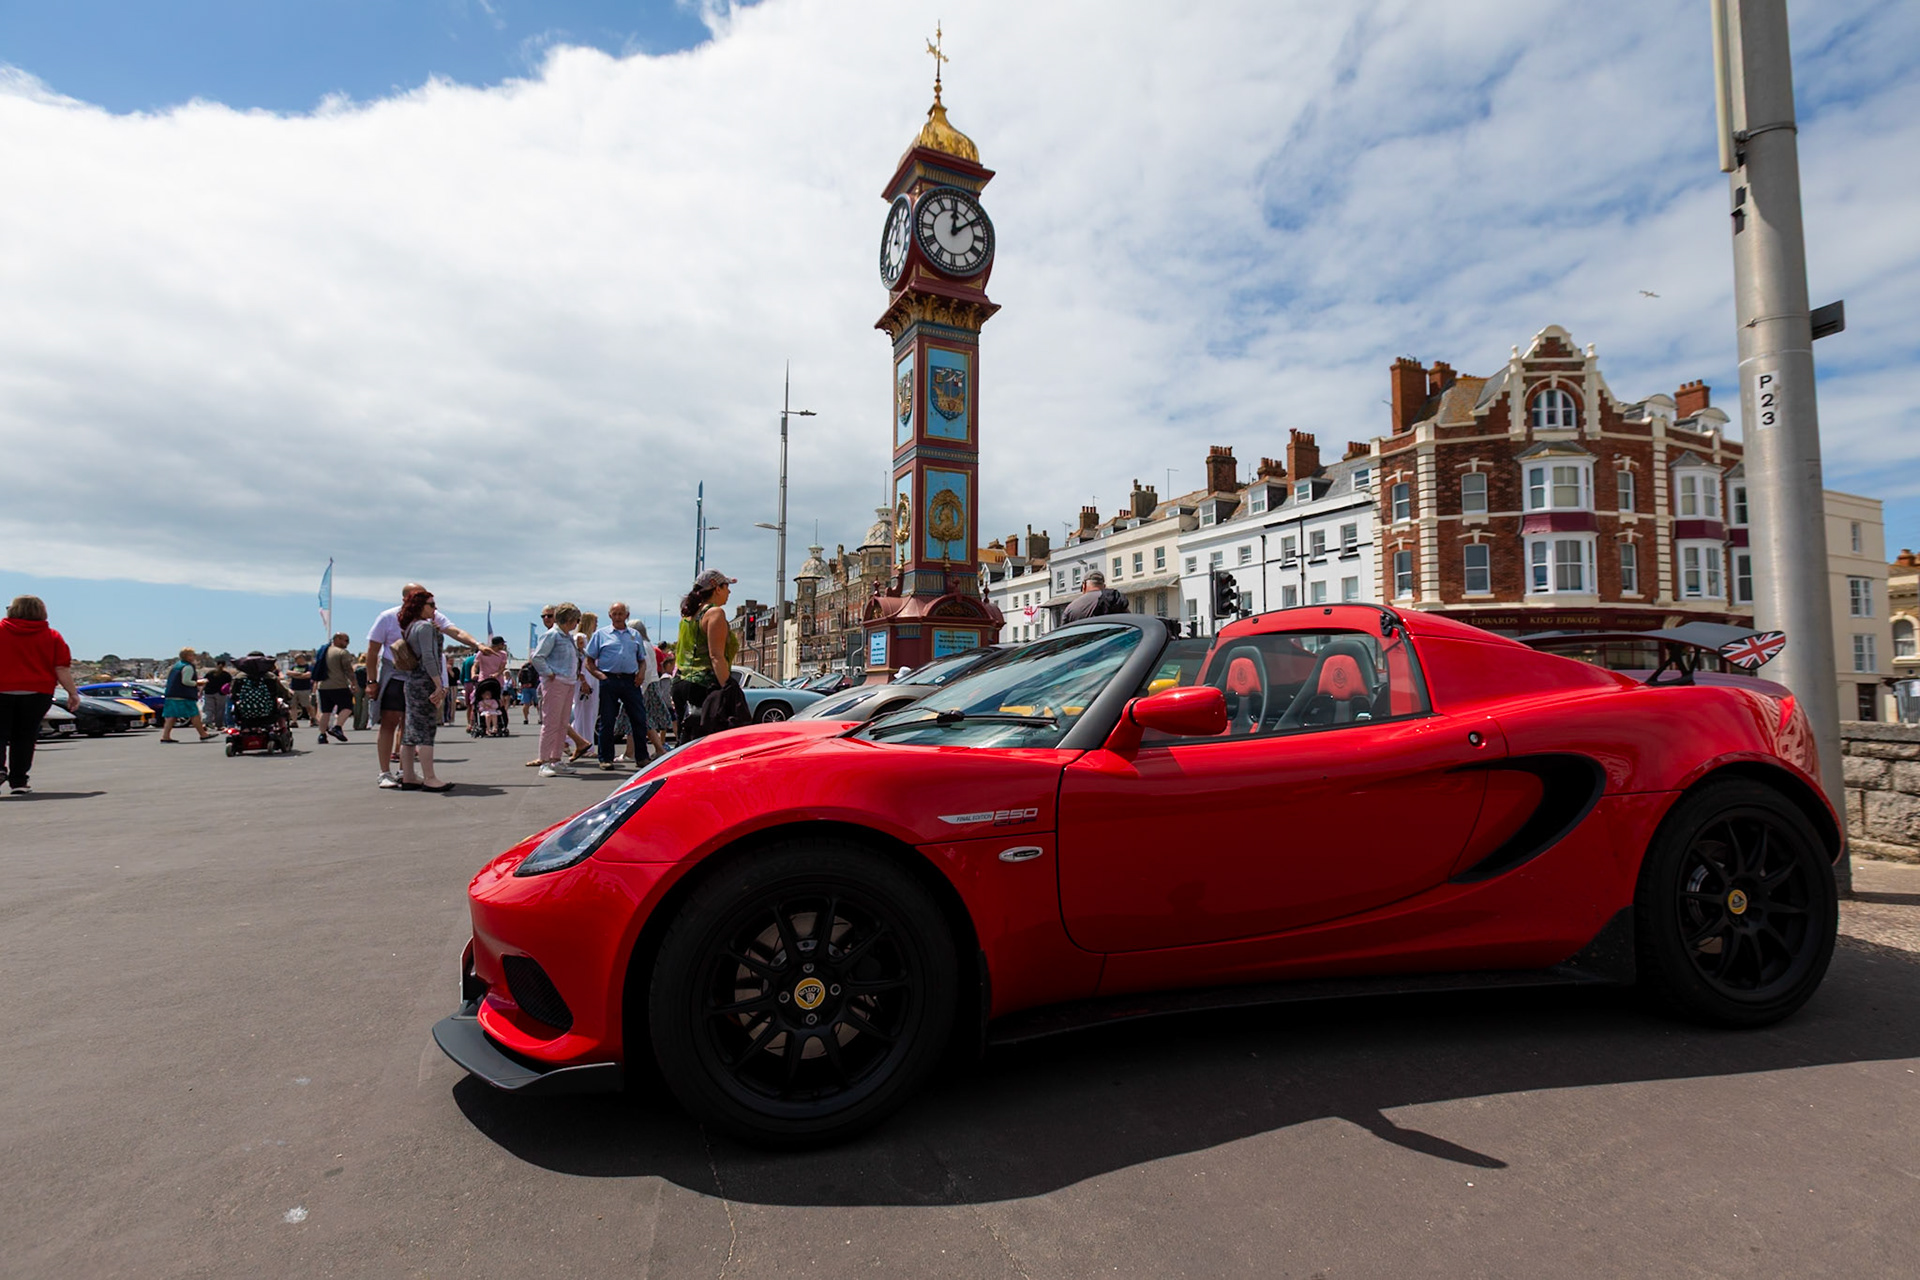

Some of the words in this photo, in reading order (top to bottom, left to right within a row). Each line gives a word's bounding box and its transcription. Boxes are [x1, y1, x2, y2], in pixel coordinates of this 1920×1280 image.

[1471, 617, 1518, 625] EDWARDS
[1529, 616, 1553, 624] KING
[1556, 616, 1601, 624] EDWARDS
[994, 808, 1038, 820] 250
